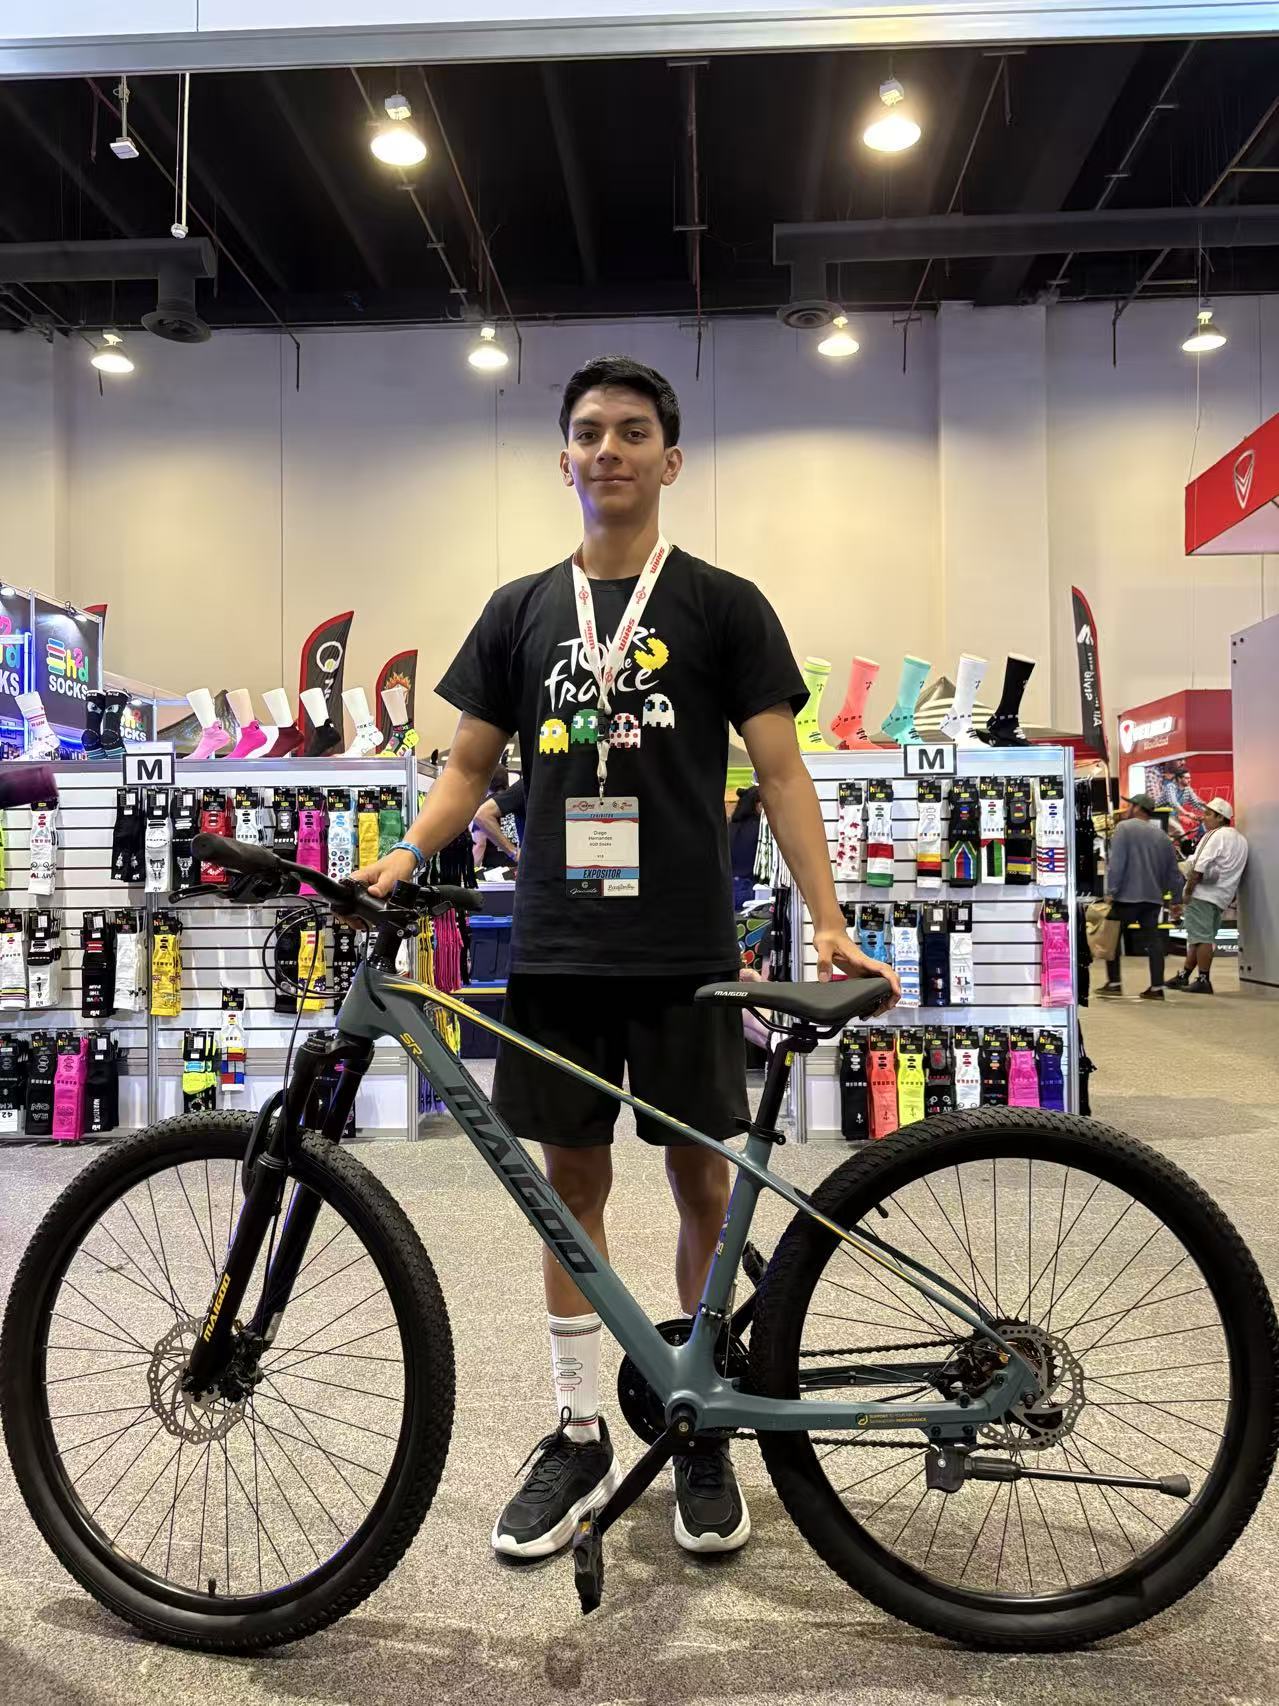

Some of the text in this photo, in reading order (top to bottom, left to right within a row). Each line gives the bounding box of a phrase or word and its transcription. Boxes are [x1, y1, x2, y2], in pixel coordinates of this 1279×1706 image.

[650, 546, 665, 574] SRAM
[586, 619, 596, 651] SRAM
[618, 617, 636, 652] SRAM
[66, 647, 89, 683] h2d
[48, 674, 88, 701] SOCKS
[544, 659, 660, 713] frace
[137, 759, 163, 780] M
[918, 748, 945, 770] M
[583, 869, 622, 879] EXPOSITOR
[400, 1032, 423, 1055] SR
[445, 1085, 598, 1274] MAIGOO
[203, 1272, 231, 1343] MAIGOO
